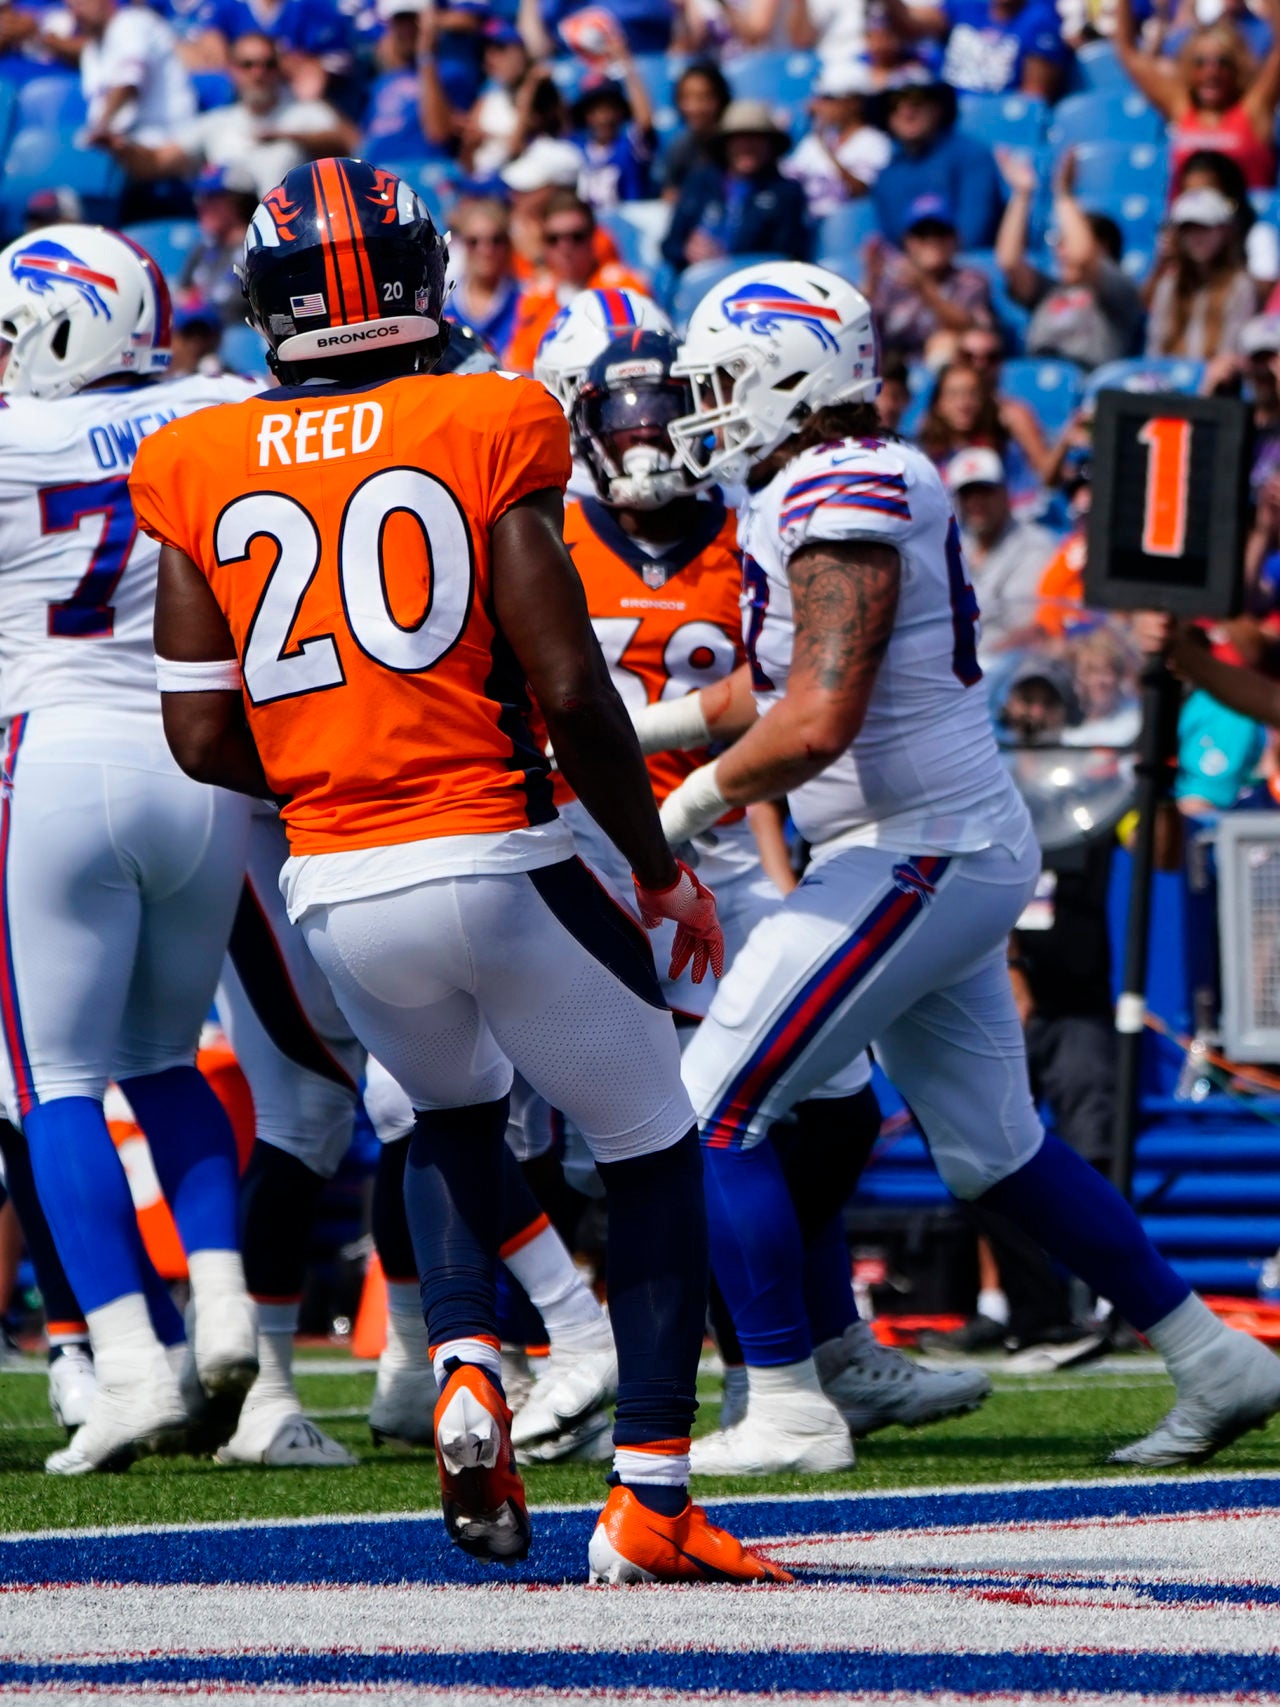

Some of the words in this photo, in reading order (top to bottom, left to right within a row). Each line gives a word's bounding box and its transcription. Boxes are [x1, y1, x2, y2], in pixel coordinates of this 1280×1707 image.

[383, 281, 404, 301] 20
[317, 325, 400, 348] BRONCOS
[88, 409, 176, 470] OW
[257, 401, 384, 467] REED
[1137, 415, 1193, 558] 1
[213, 465, 473, 706] 20
[620, 598, 687, 612] BRONCOS
